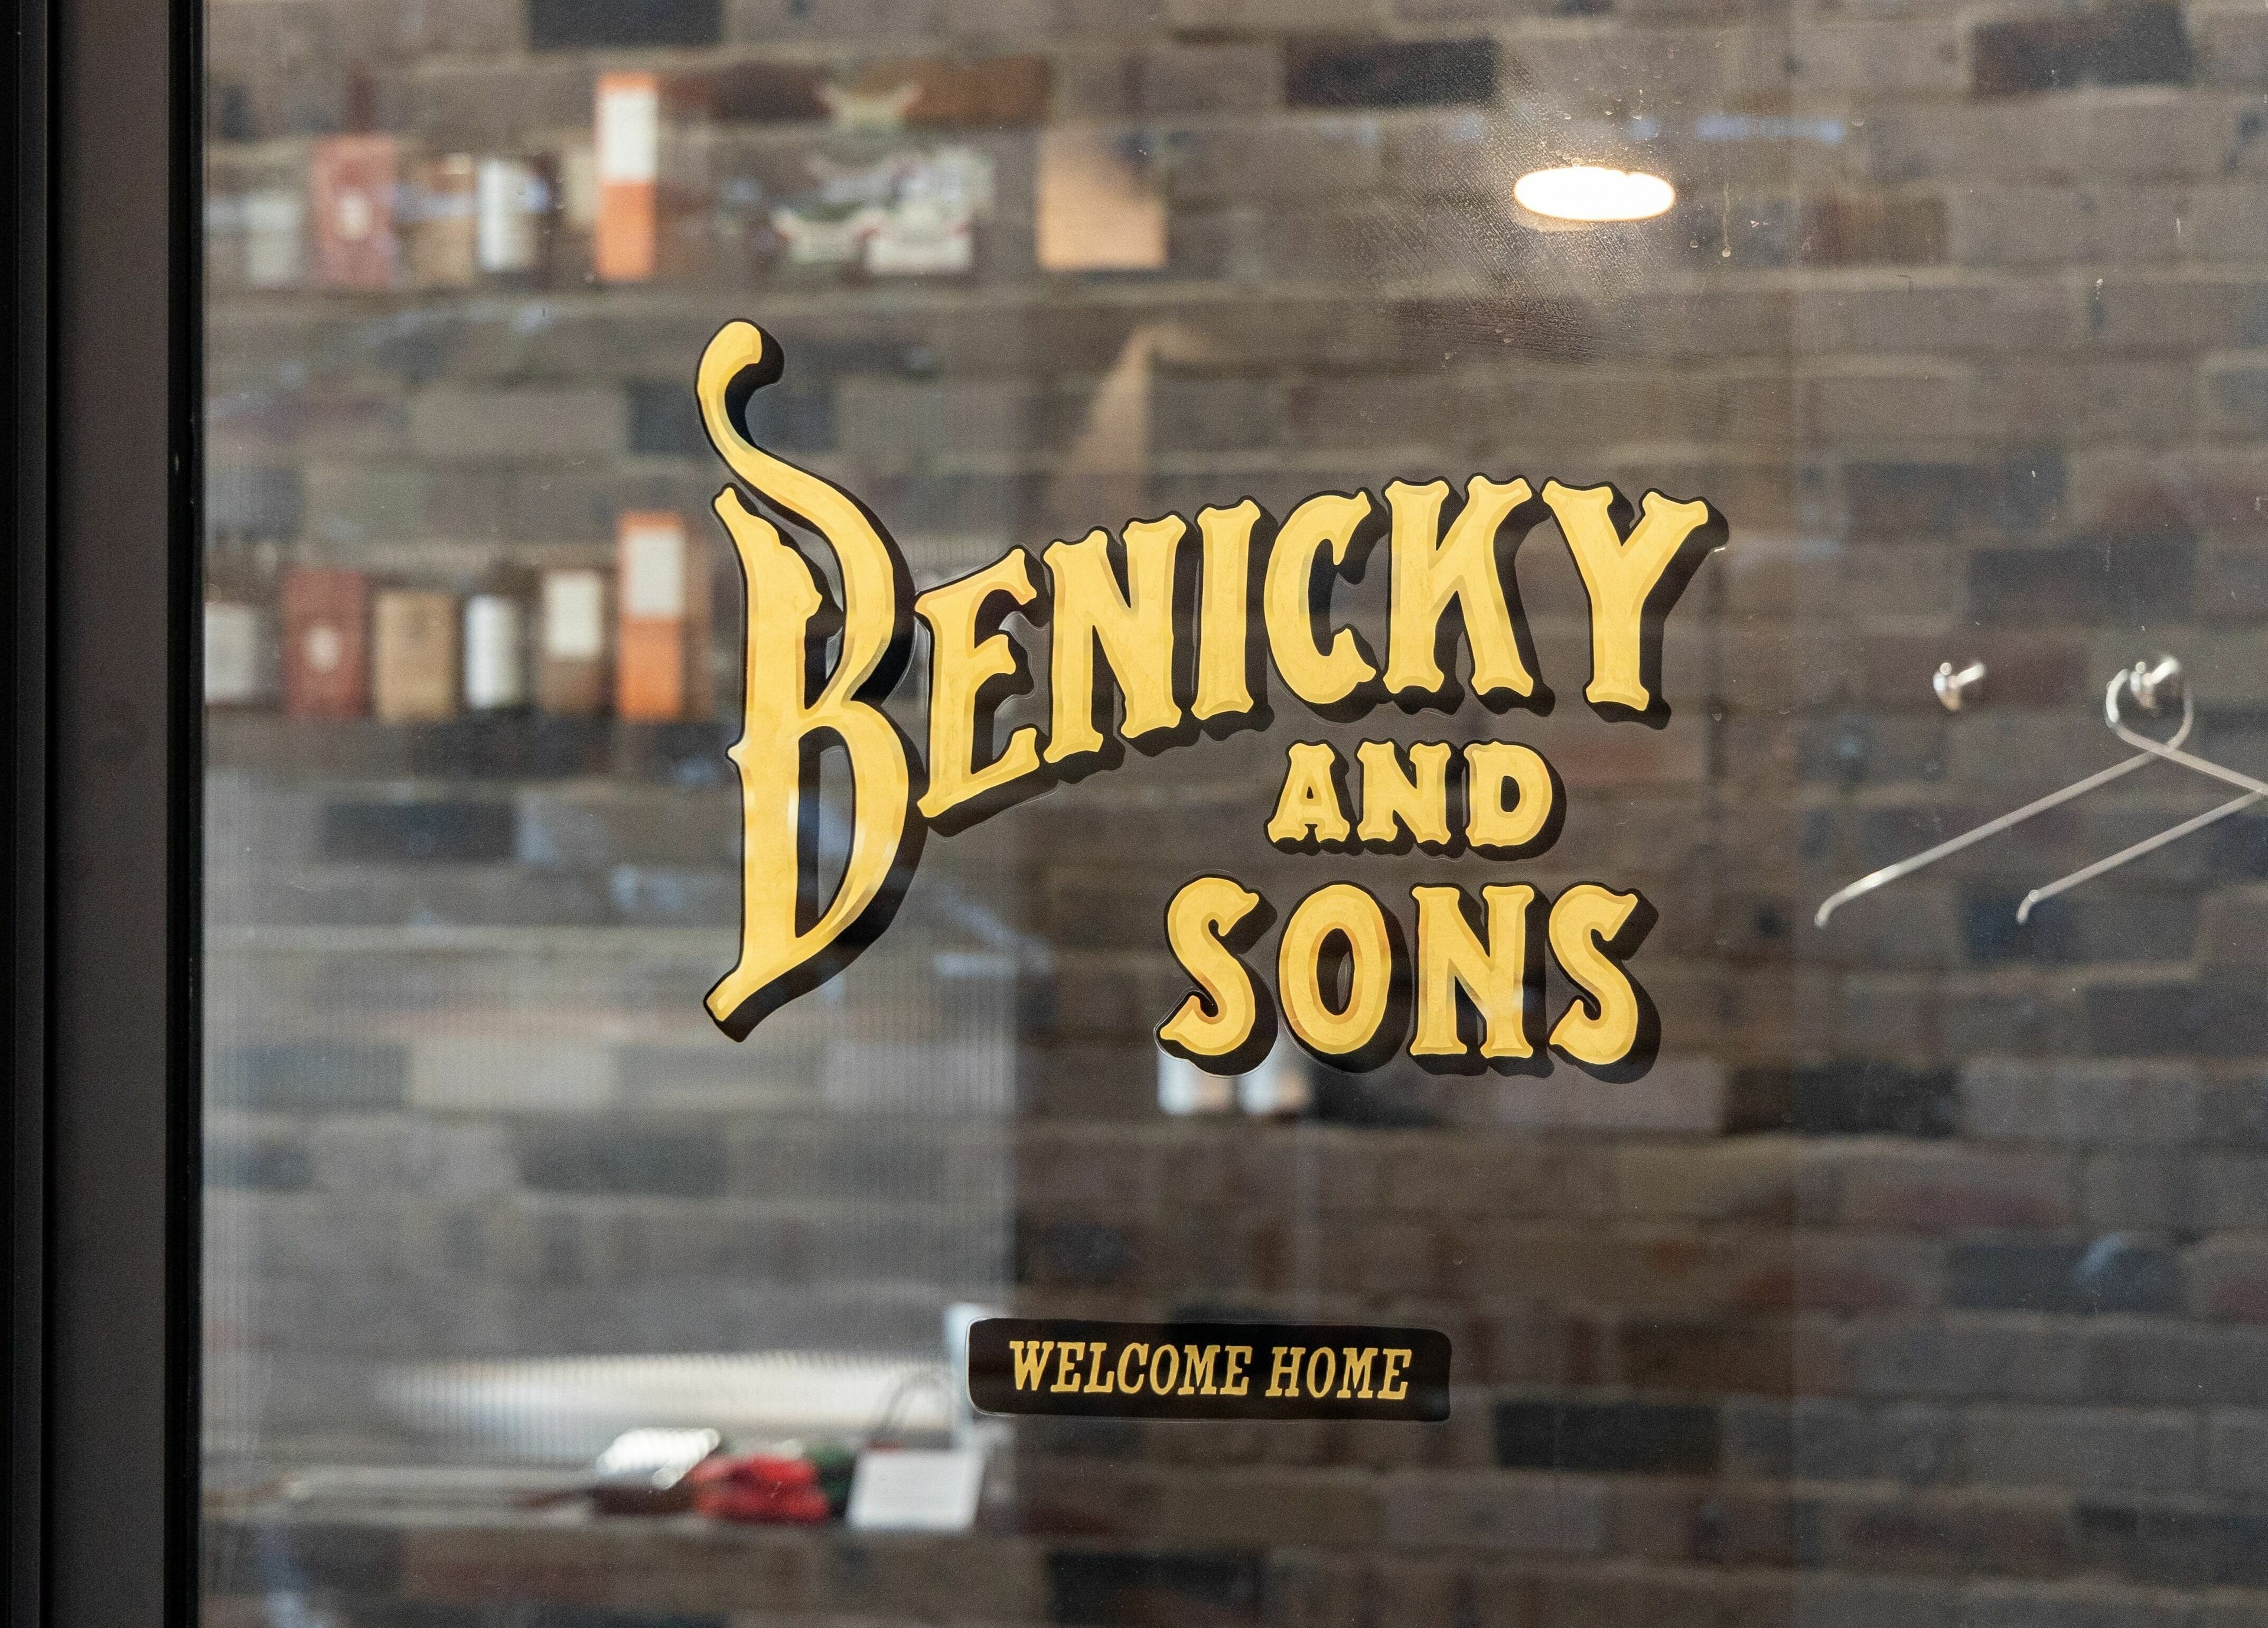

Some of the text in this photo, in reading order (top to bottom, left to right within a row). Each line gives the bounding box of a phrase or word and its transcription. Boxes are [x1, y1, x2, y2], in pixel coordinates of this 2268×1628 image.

[697, 320, 1712, 1023] BENICKY
[1266, 740, 1556, 848] AND
[1159, 877, 1640, 1064] SONS
[1009, 1340, 1412, 1401] WELCOME HOME
